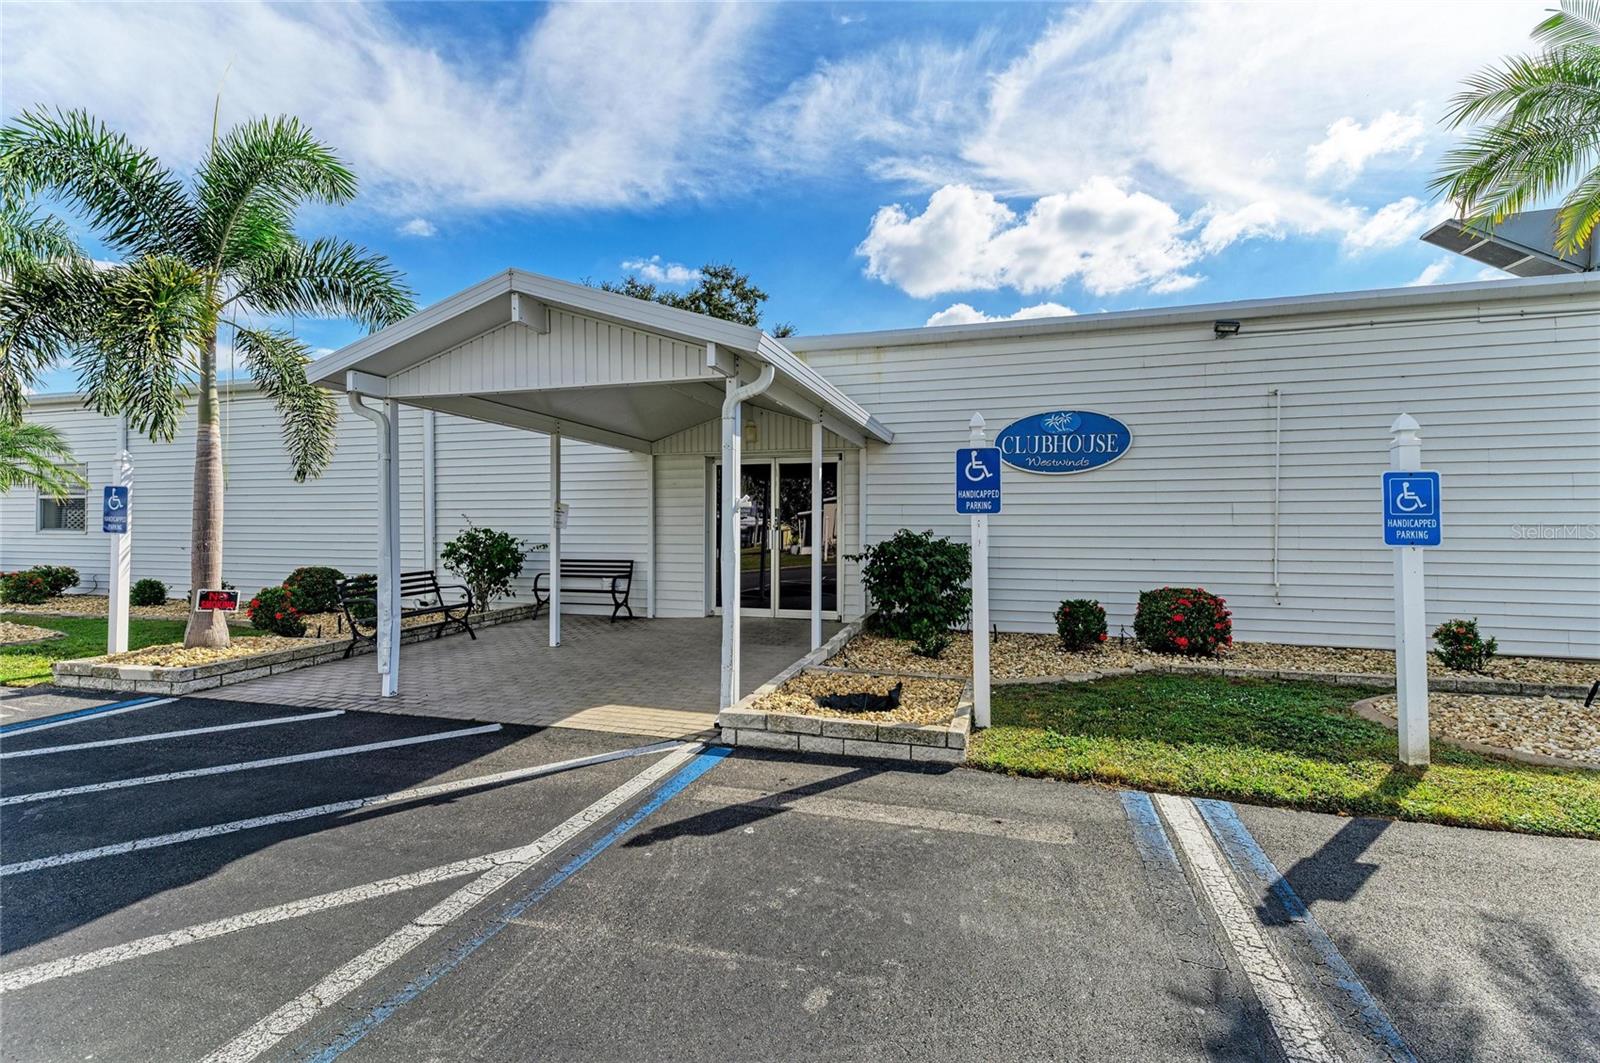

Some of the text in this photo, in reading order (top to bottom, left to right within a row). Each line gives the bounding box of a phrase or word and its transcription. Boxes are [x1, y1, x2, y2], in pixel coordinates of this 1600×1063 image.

[1001, 433, 1118, 454] CLUBHOUSE
[1026, 456, 1090, 467] Westwinds
[958, 489, 999, 499] HANDICAPPED
[965, 501, 992, 510] PARKING
[1387, 519, 1437, 529] HANDICAPPED
[1396, 530, 1429, 540] PARKING
